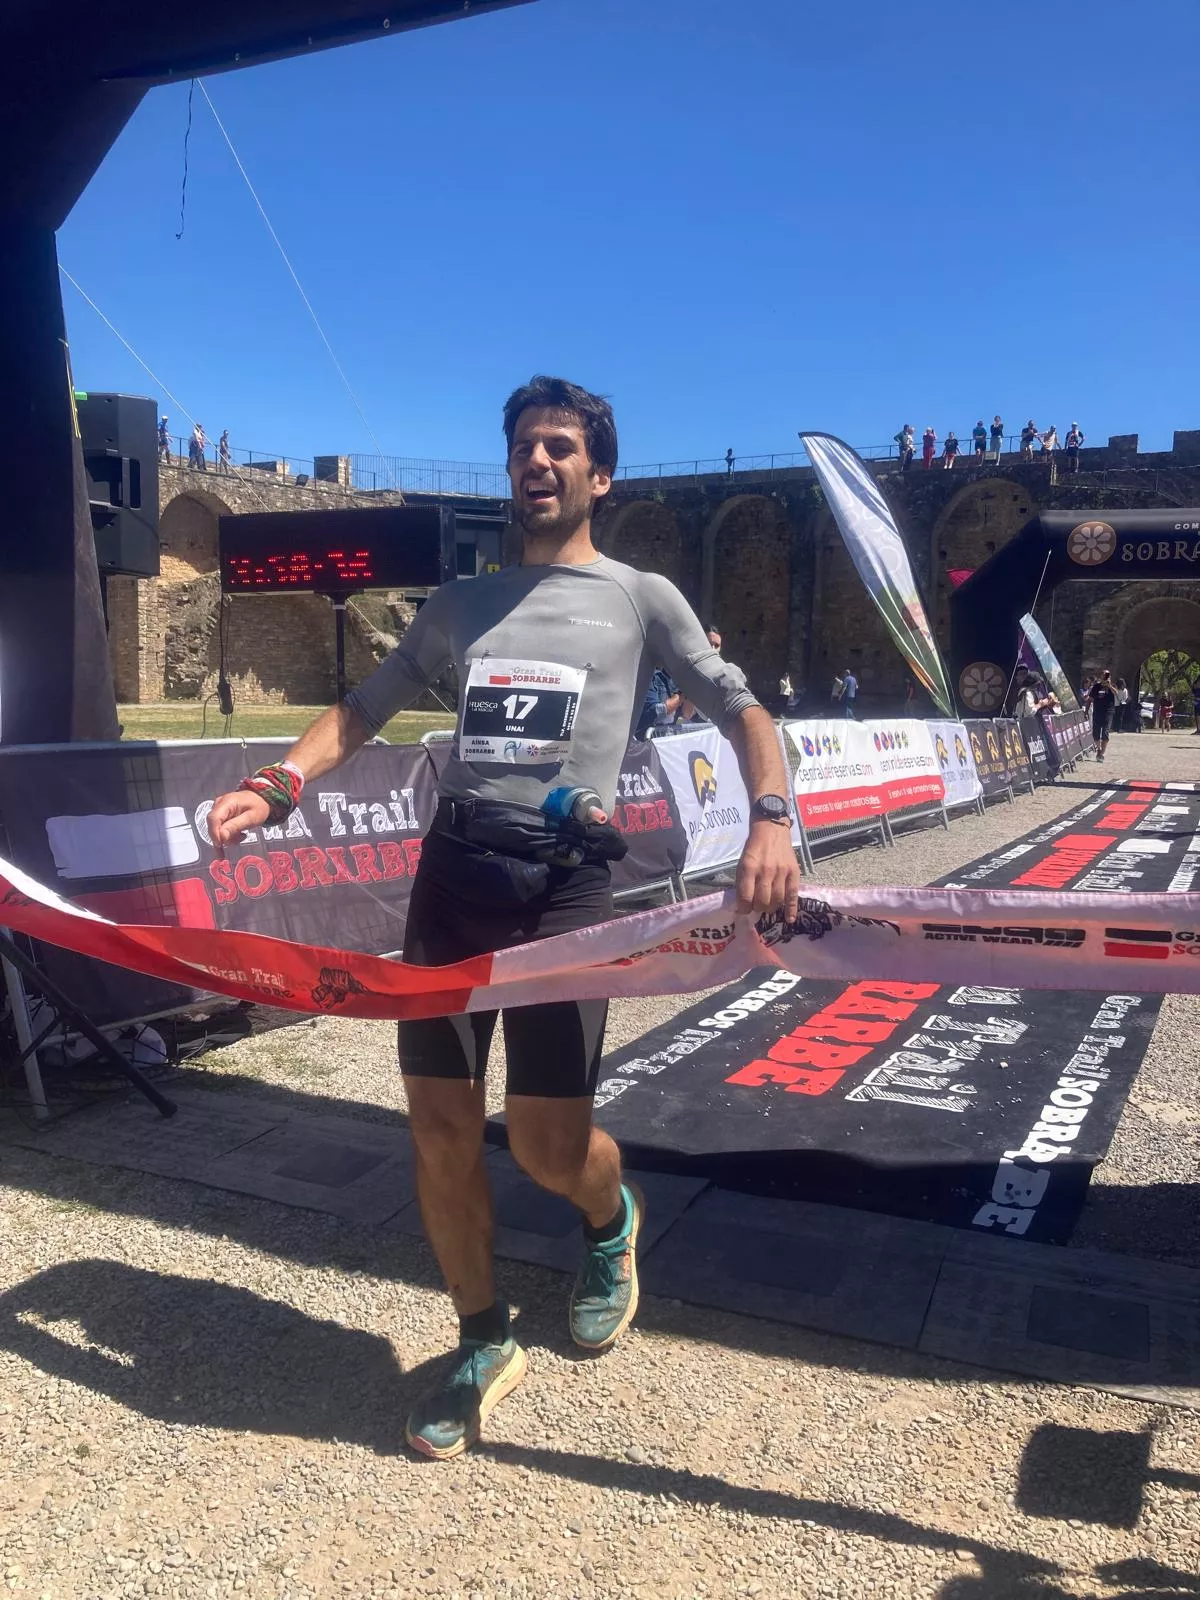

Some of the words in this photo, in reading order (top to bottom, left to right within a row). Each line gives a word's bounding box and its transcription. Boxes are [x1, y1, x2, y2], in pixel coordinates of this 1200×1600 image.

[512, 674, 561, 685] SOBRARBE
[502, 694, 539, 720] 17
[505, 725, 525, 733] UNAI
[317, 787, 420, 838] Trail
[924, 932, 977, 942] ACTIVE
[982, 935, 1034, 945] WEAR
[209, 965, 248, 983] Gran
[251, 966, 285, 989] Trail
[1090, 994, 1143, 1029] Gran
[616, 1028, 722, 1076] Trail
[844, 1014, 1030, 1113] Trail
[1061, 1034, 1126, 1080] Trail
